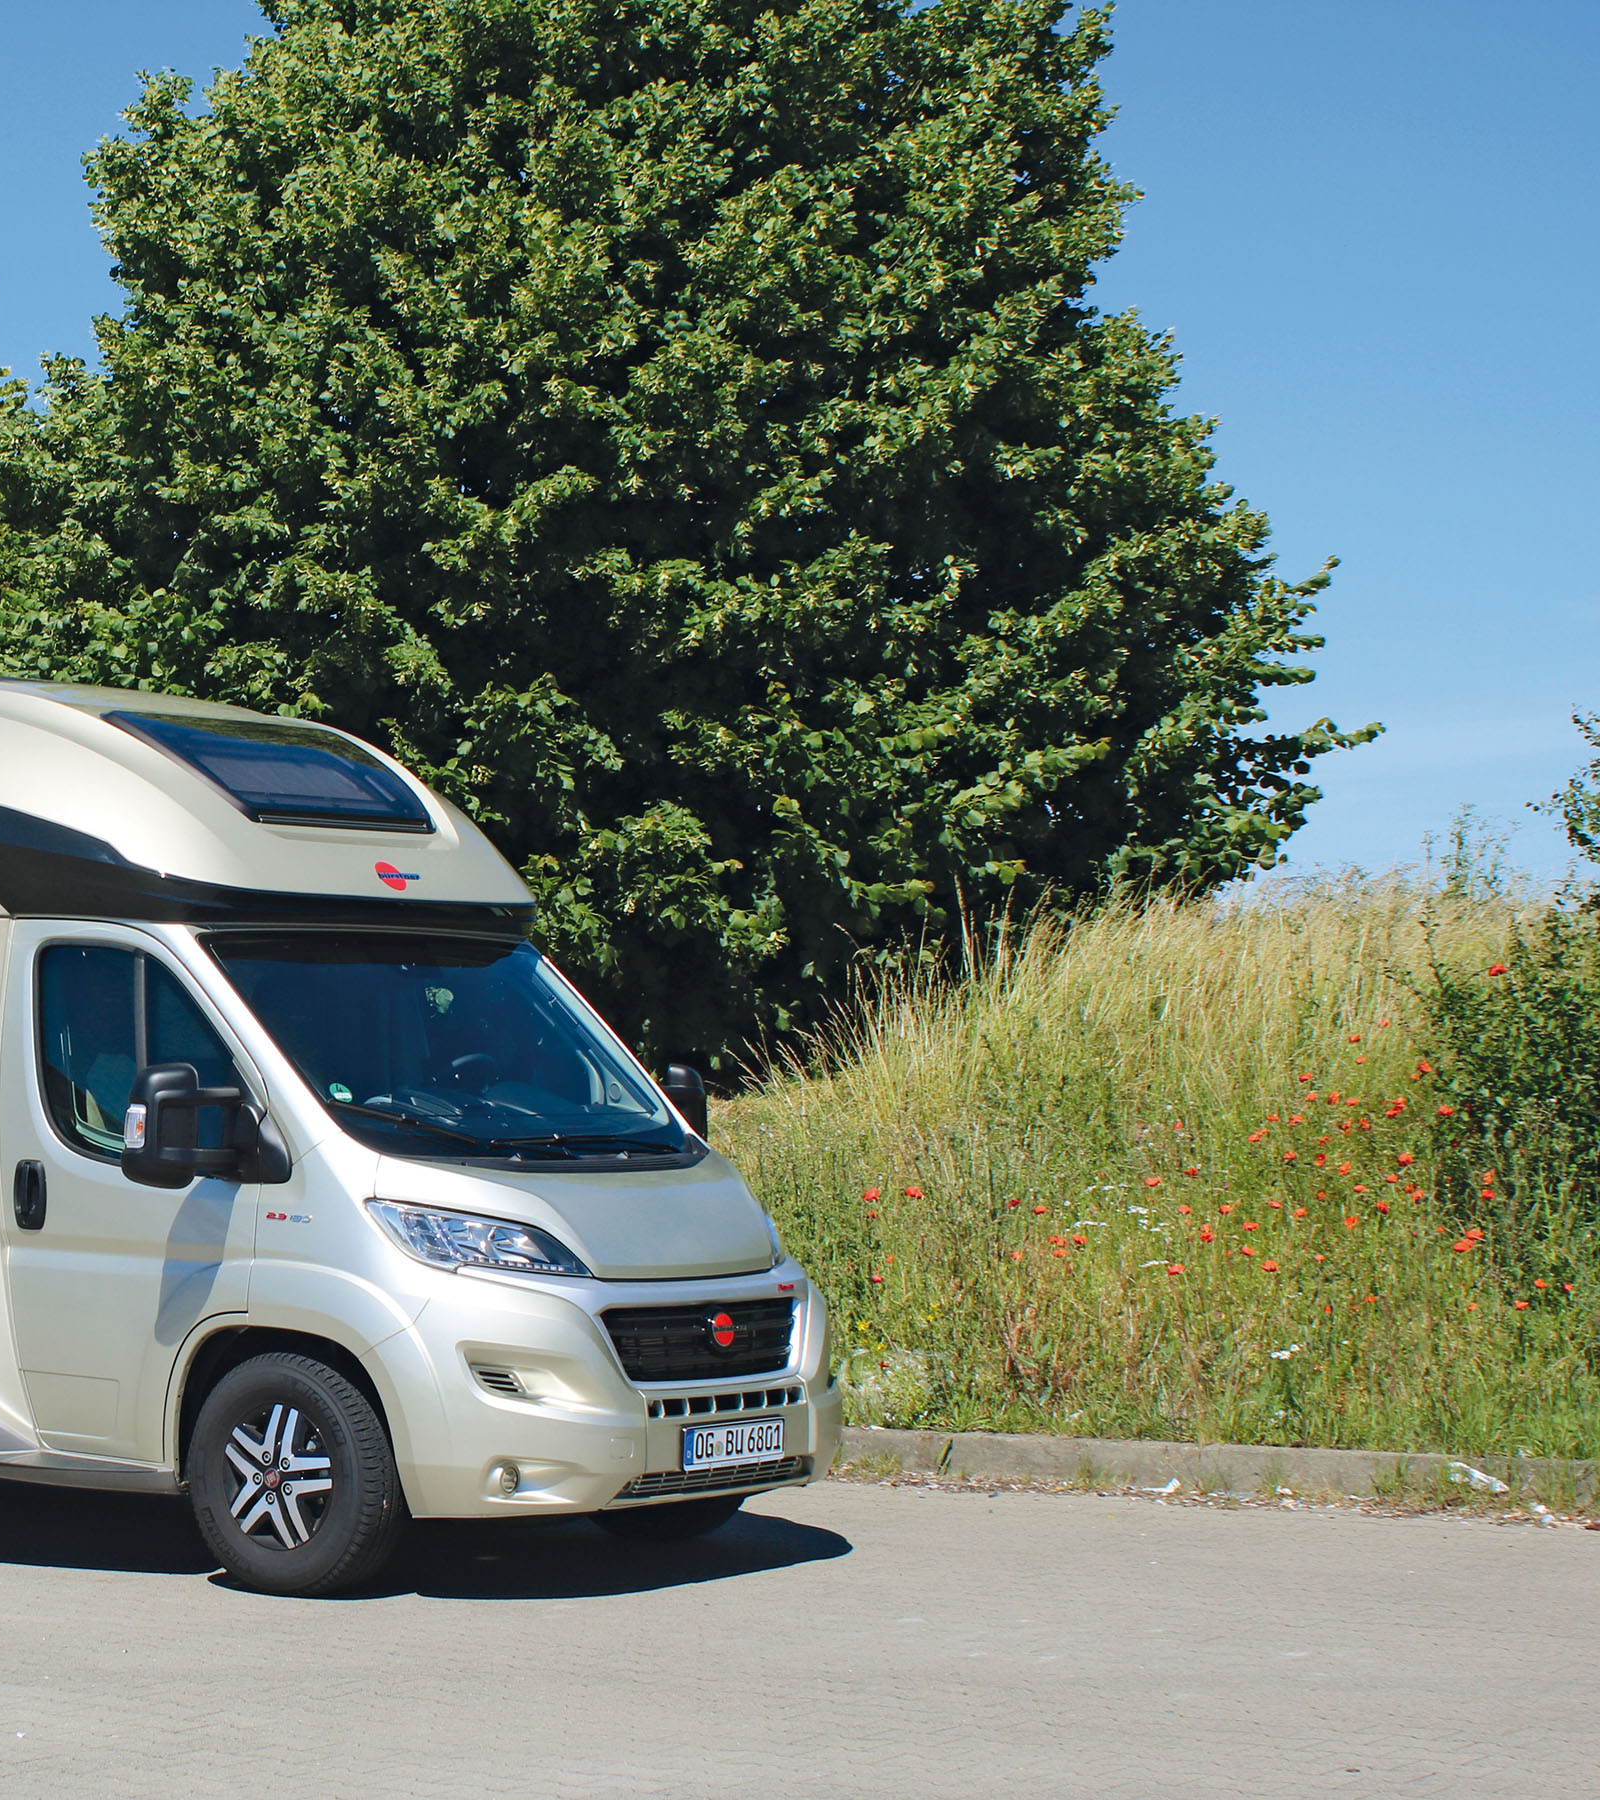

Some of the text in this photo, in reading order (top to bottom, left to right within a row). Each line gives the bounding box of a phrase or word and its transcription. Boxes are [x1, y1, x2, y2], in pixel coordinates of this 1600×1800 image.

[695, 1424, 780, 1459] OG BU 6801
